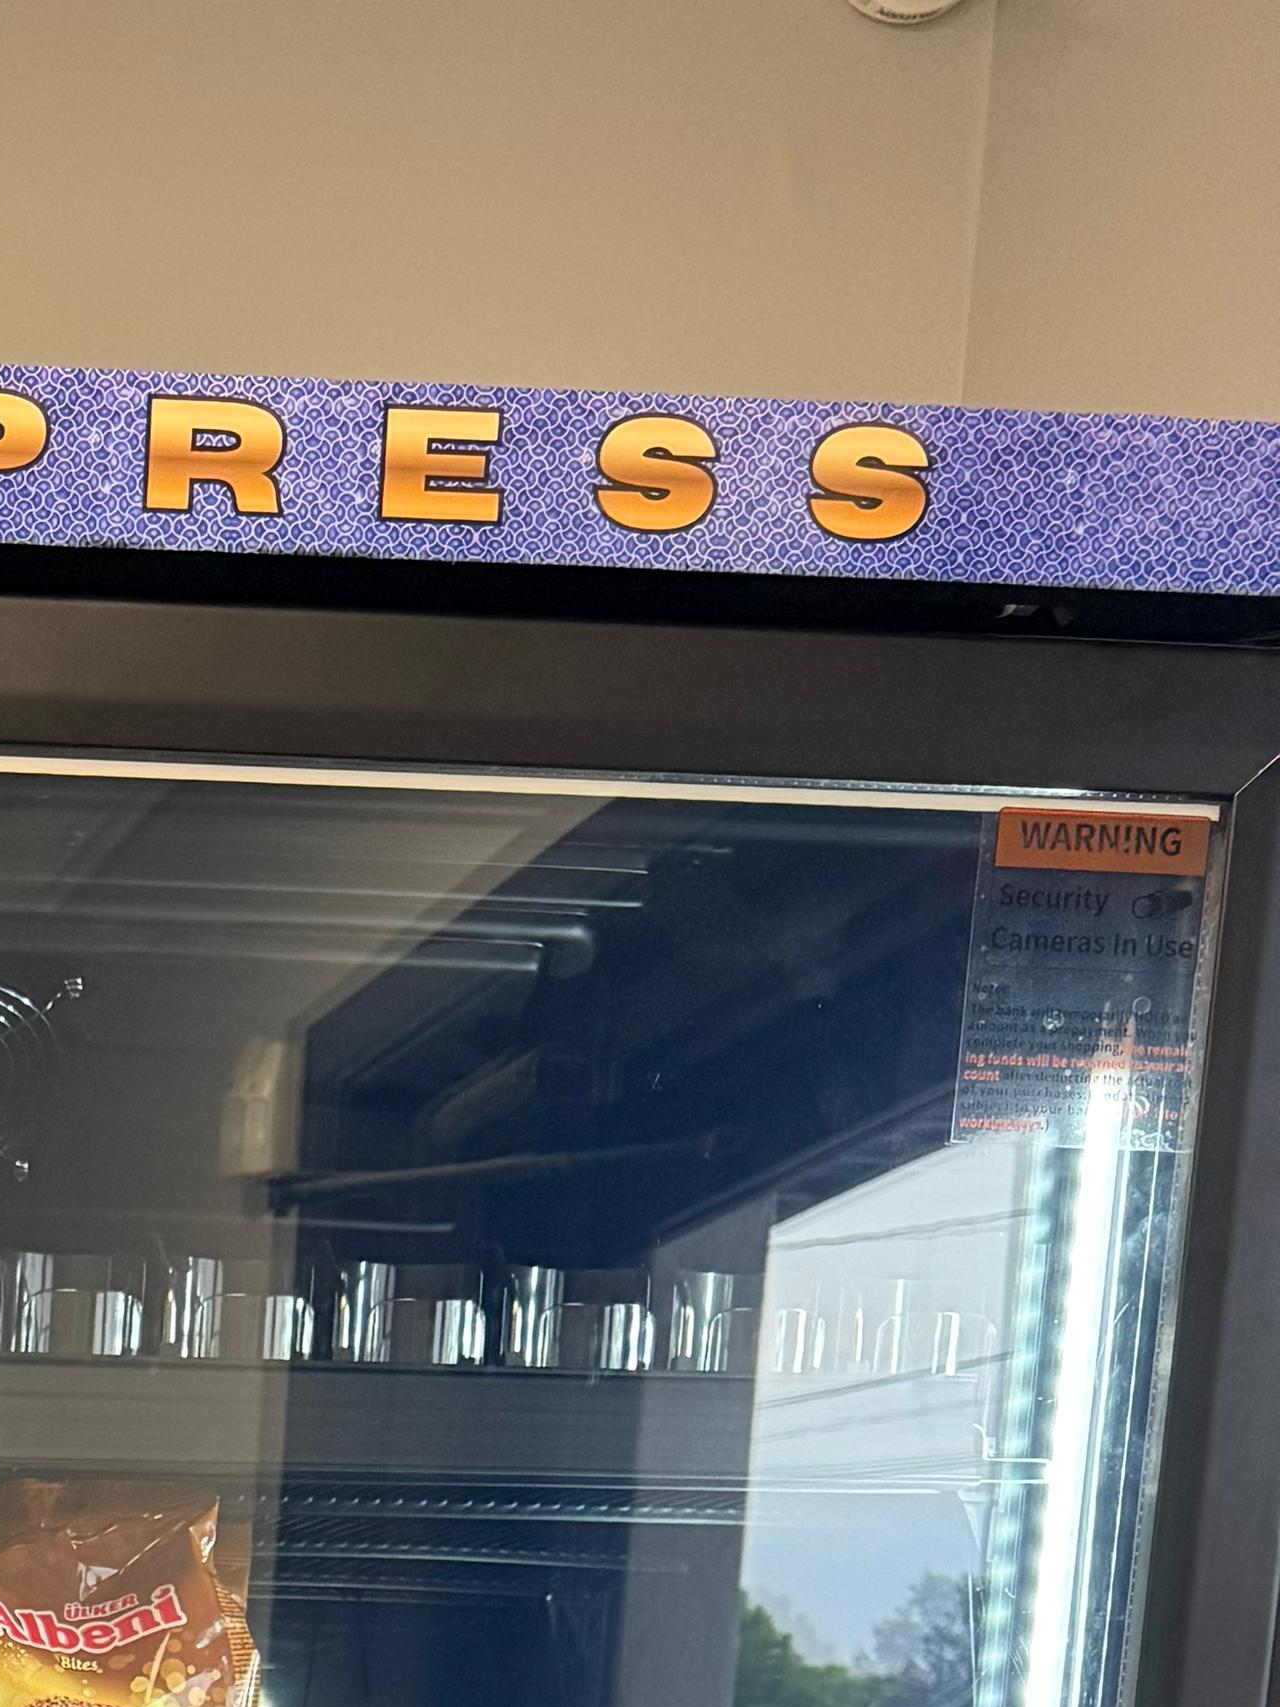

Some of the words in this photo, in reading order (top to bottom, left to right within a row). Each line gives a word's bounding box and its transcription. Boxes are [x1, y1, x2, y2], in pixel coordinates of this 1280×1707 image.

[1000, 883, 1110, 917] Security
[991, 926, 1104, 954] Cameras
[1114, 936, 1135, 956] In
[1147, 937, 1193, 958] Use
[64, 1592, 137, 1622] ÜLKER
[59, 1655, 100, 1672] Bites
